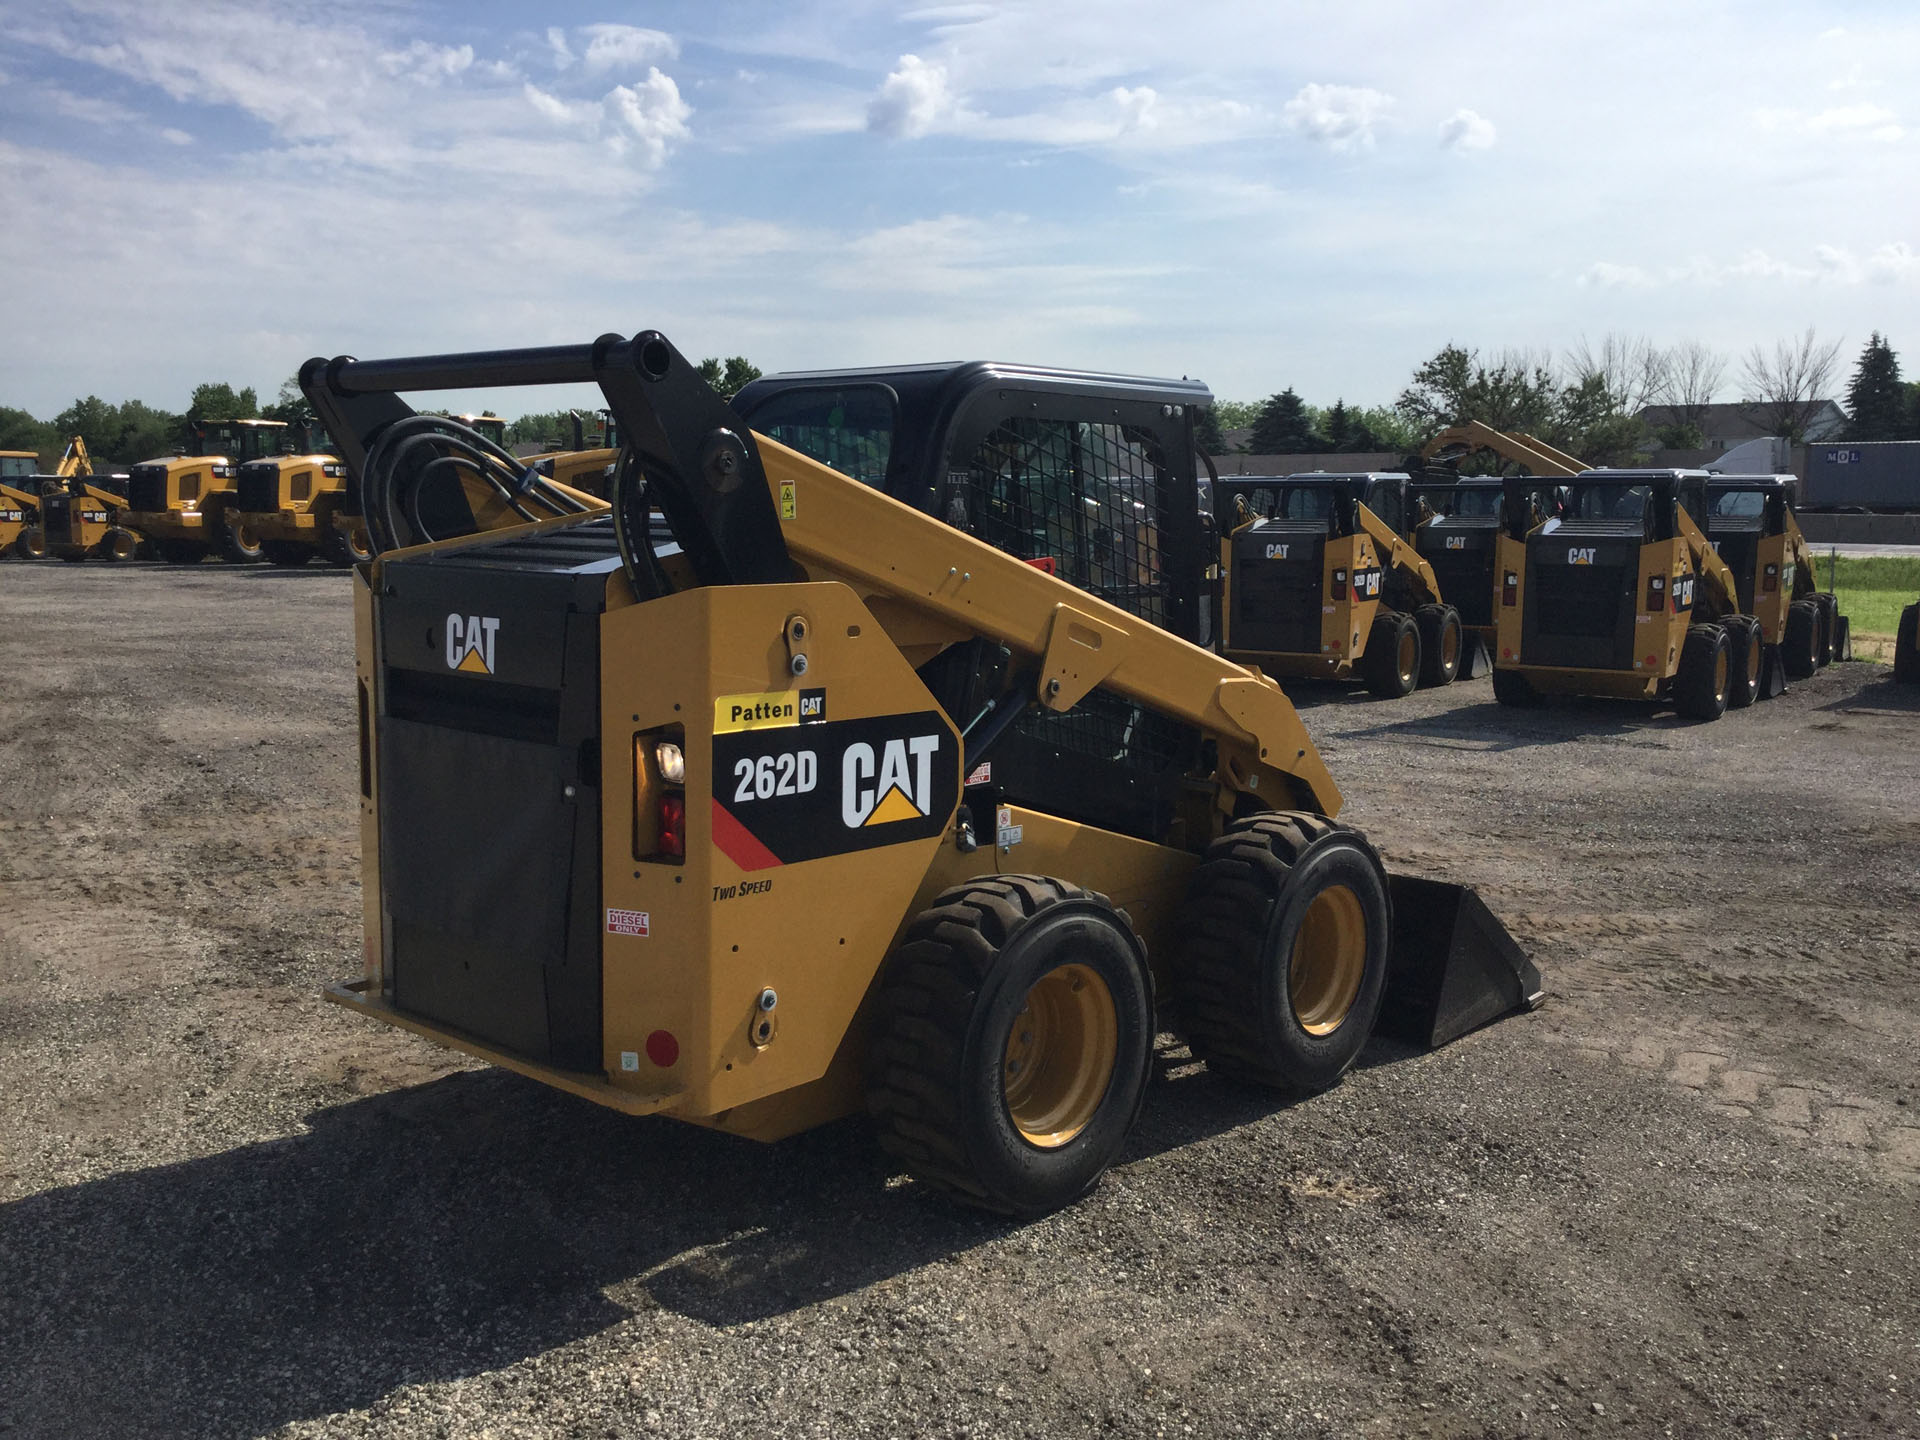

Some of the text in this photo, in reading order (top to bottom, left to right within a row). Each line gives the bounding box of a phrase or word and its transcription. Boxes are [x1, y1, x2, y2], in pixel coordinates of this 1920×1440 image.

[1827, 451, 1859, 462] MOL
[9, 511, 22, 521] CAT
[94, 512, 107, 522] CAT
[1446, 536, 1466, 549] CAT
[1266, 544, 1289, 559] CAT
[1568, 548, 1596, 565] CAT
[1366, 572, 1380, 596] CAT
[446, 613, 500, 674] CAT
[731, 697, 823, 722] Patten CAT
[734, 734, 939, 829] 262D CAT
[609, 914, 647, 926] DIESEL
[615, 925, 640, 935] ONLY
